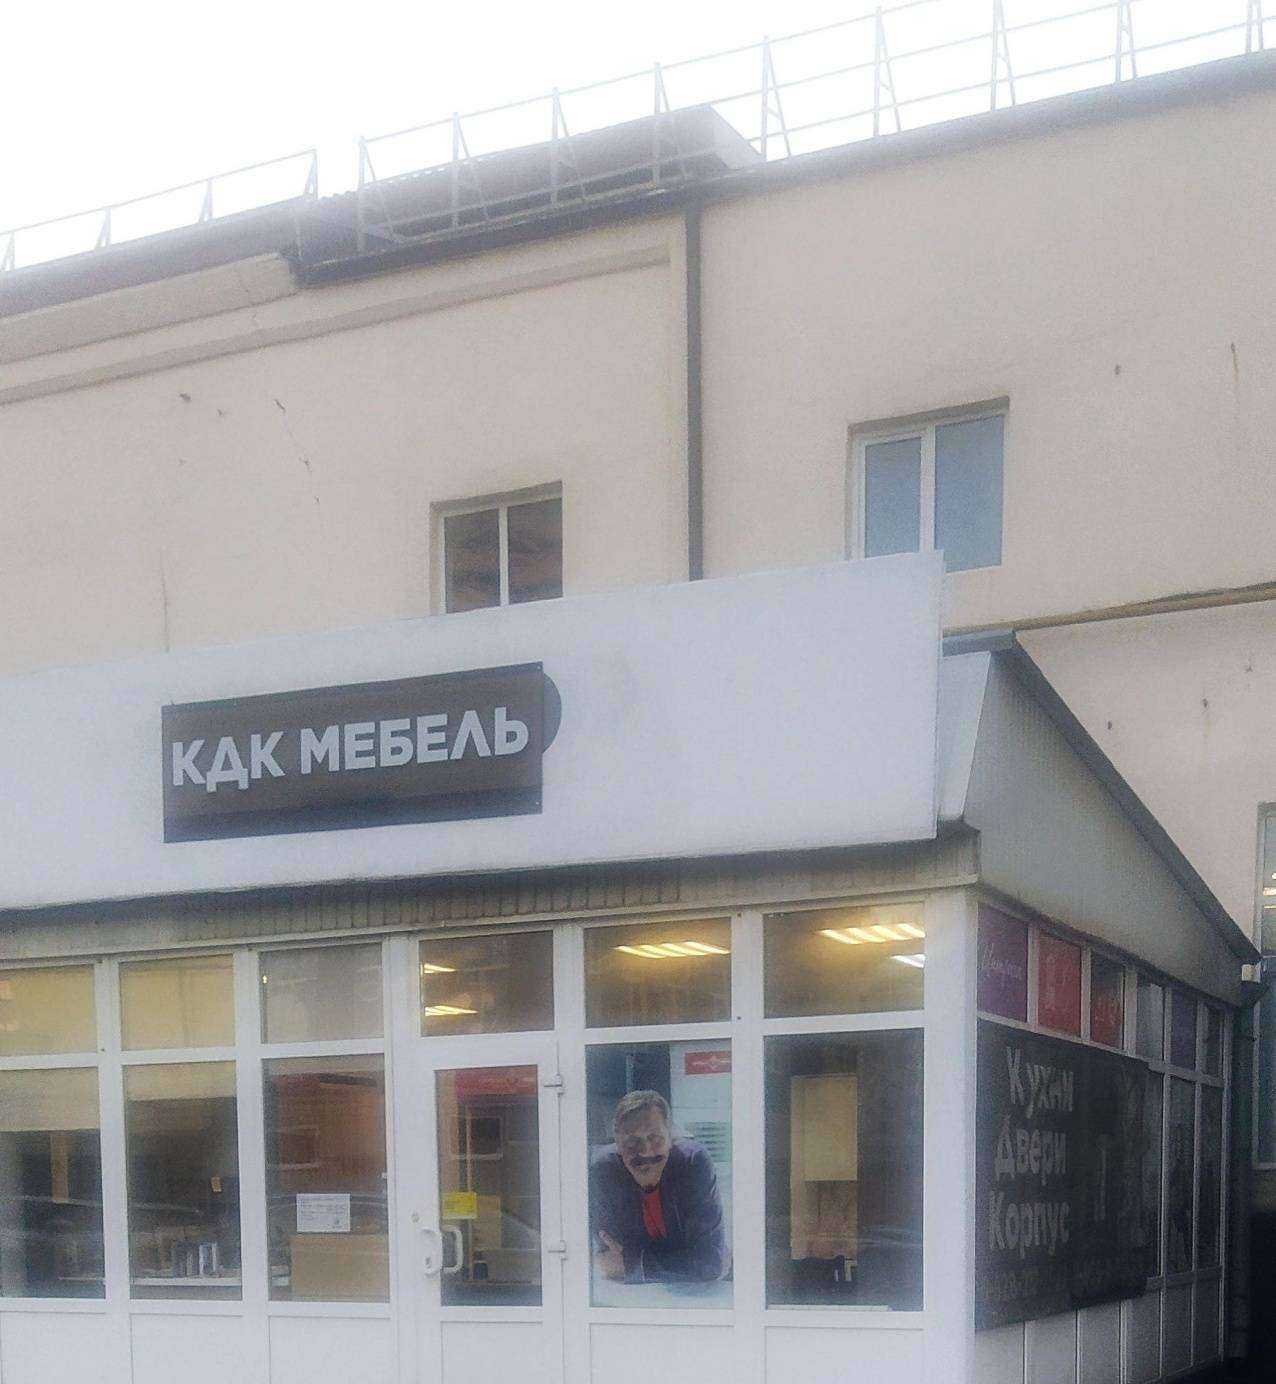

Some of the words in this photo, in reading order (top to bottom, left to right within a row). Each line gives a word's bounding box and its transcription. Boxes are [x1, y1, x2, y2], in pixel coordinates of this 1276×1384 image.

[172, 731, 286, 792] КДК
[301, 707, 529, 774] МЕБЕЛЬ
[1006, 1046, 1074, 1118] Кухни
[995, 1113, 1067, 1186] Двери
[988, 1190, 1072, 1259] Корпус
